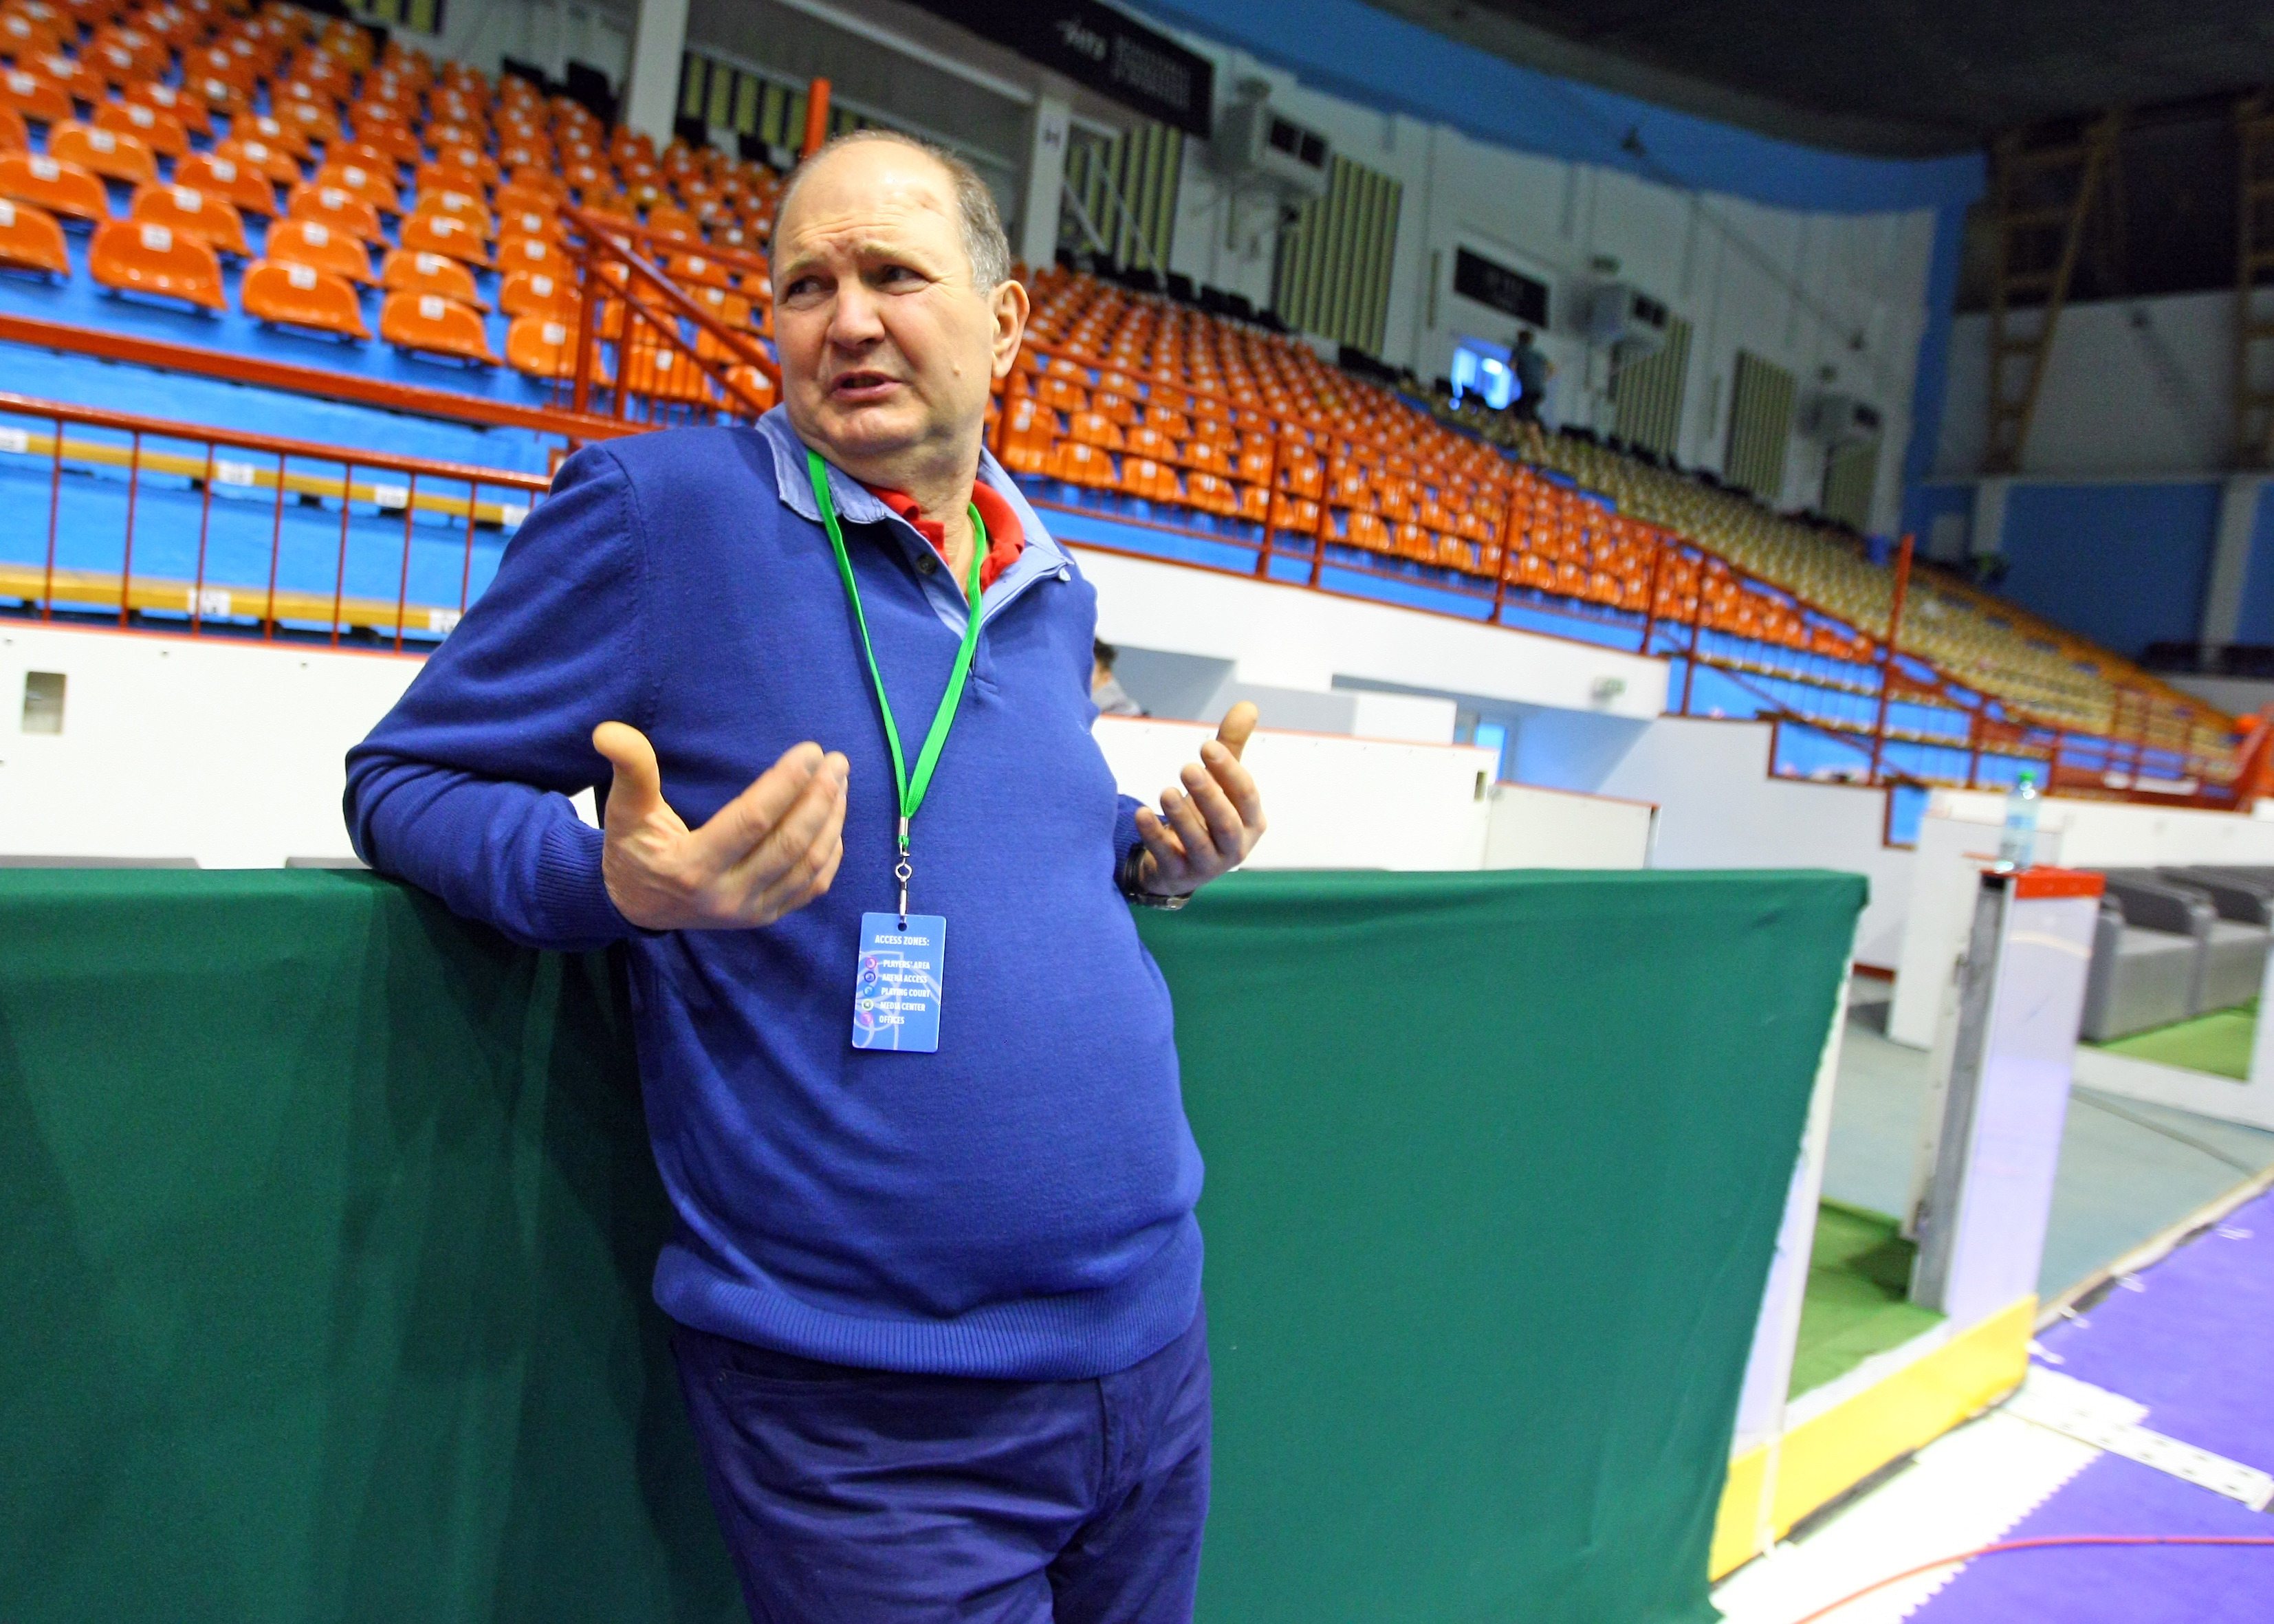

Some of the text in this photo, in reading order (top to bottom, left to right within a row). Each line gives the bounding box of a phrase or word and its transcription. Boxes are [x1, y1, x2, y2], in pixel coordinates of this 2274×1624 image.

[875, 935, 930, 946] ACCESS ZONES:
[913, 961, 930, 969] AREA
[882, 974, 928, 983] ARENA ACCESS
[881, 987, 931, 998] PLAYING COURT
[880, 1002, 926, 1011] MEDIA CENTER
[879, 1016, 905, 1024] OFFICES
